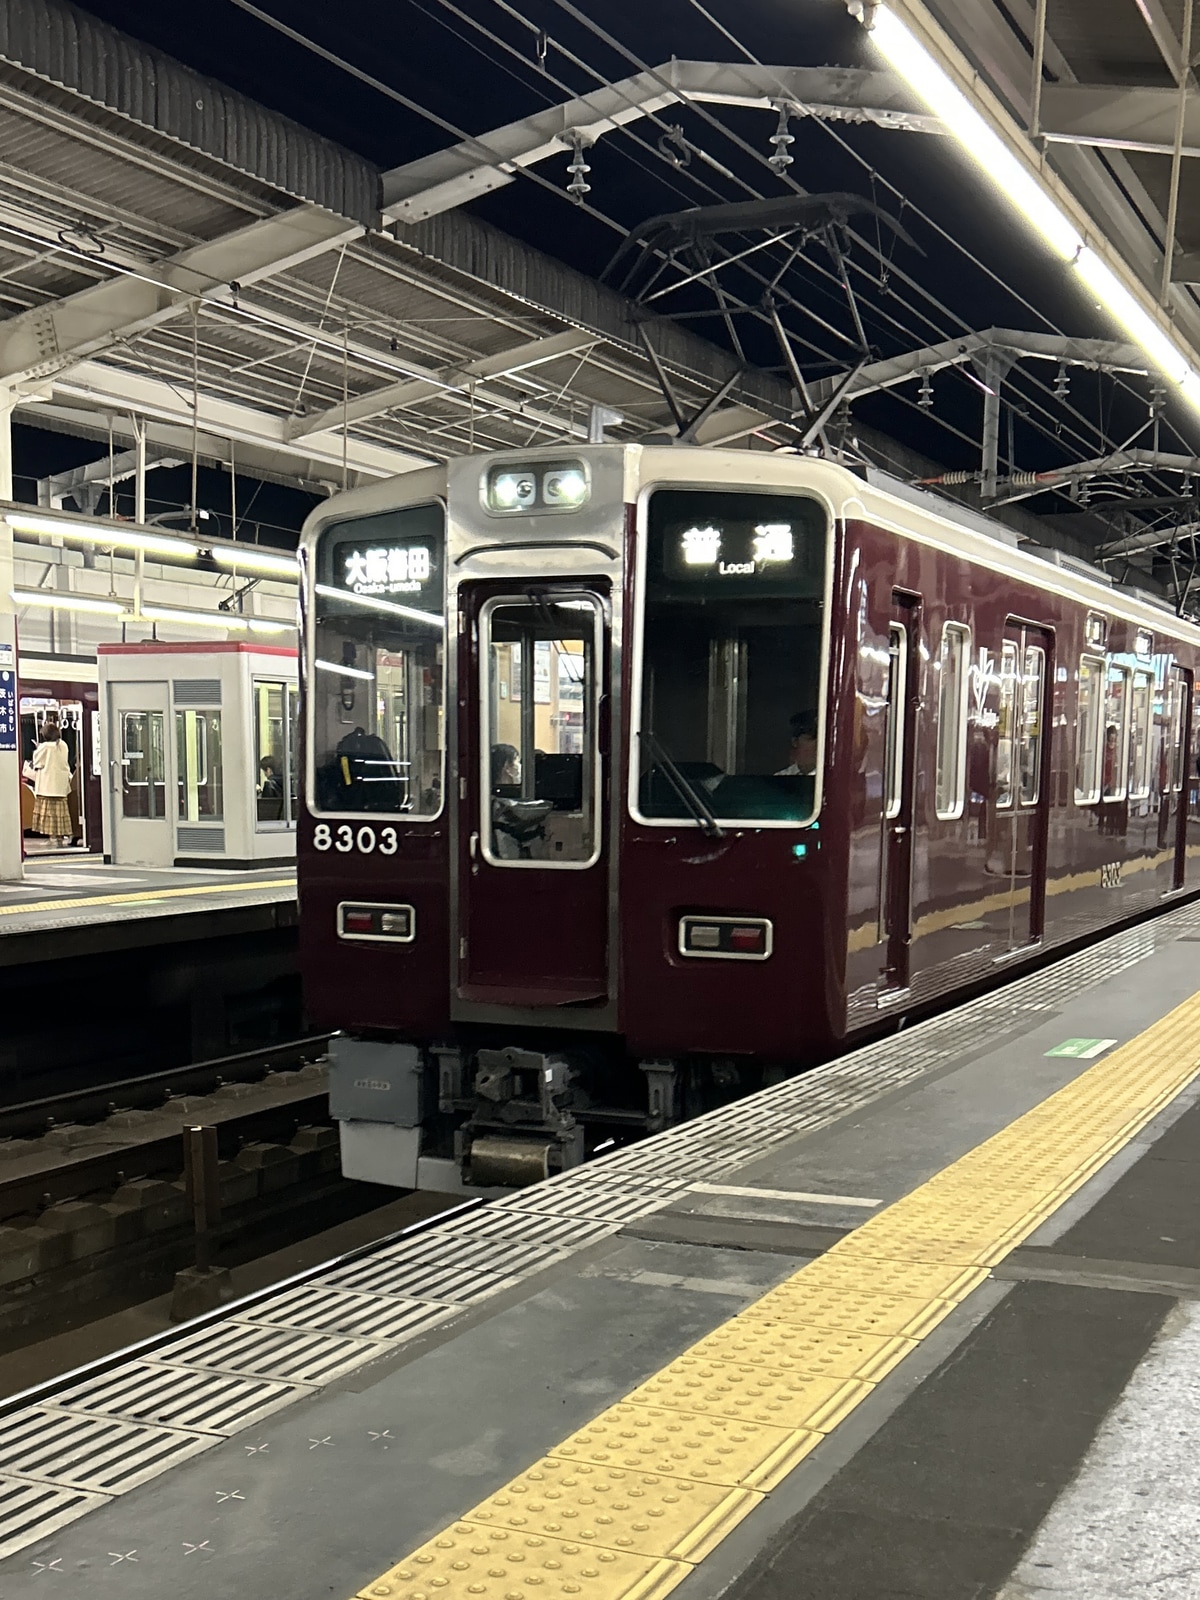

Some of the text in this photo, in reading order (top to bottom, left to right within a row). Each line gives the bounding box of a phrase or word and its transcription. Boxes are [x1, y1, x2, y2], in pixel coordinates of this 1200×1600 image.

[681, 524, 794, 564] 普通
[345, 547, 430, 585] 大阪梅田
[719, 561, 756, 575] Local
[313, 823, 398, 855] 8303
